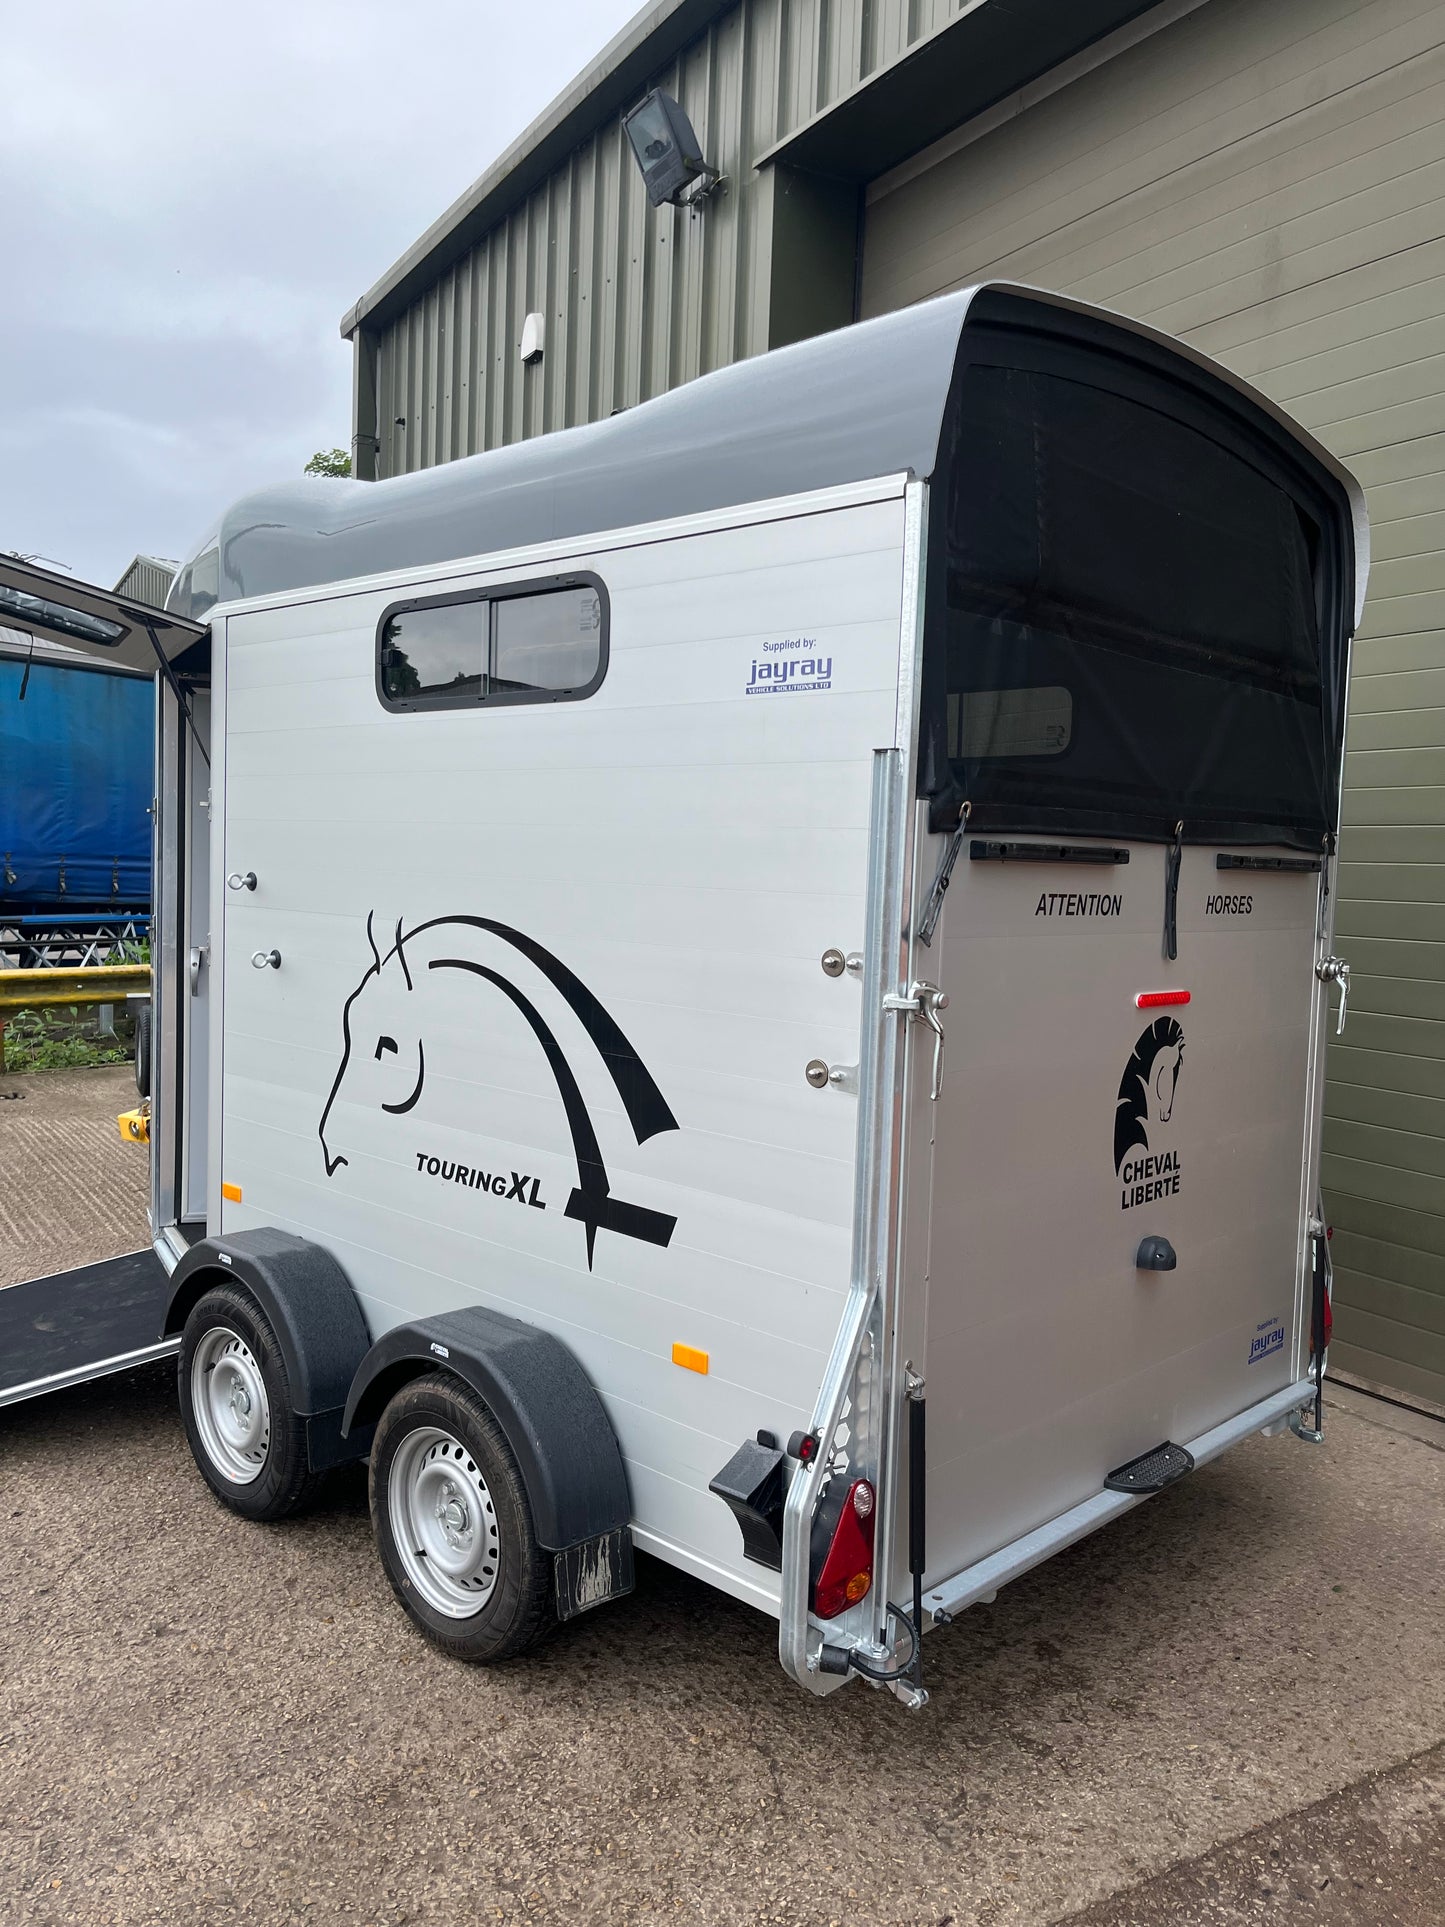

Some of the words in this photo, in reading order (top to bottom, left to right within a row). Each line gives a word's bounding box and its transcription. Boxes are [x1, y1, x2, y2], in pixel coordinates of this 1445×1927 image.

[763, 639, 801, 653] Supplied
[803, 638, 817, 650] by:
[747, 657, 832, 686] jayray
[748, 686, 774, 694] VEHICLE
[776, 683, 814, 693] SOLUTIONS
[815, 682, 829, 690] LTD
[1035, 893, 1123, 916] ATTENTION
[1206, 895, 1253, 915] HORSES
[1123, 1150, 1181, 1184] CHEVAL
[1121, 1170, 1180, 1210] LIBERTÉ
[1248, 1327, 1285, 1359] jayray
